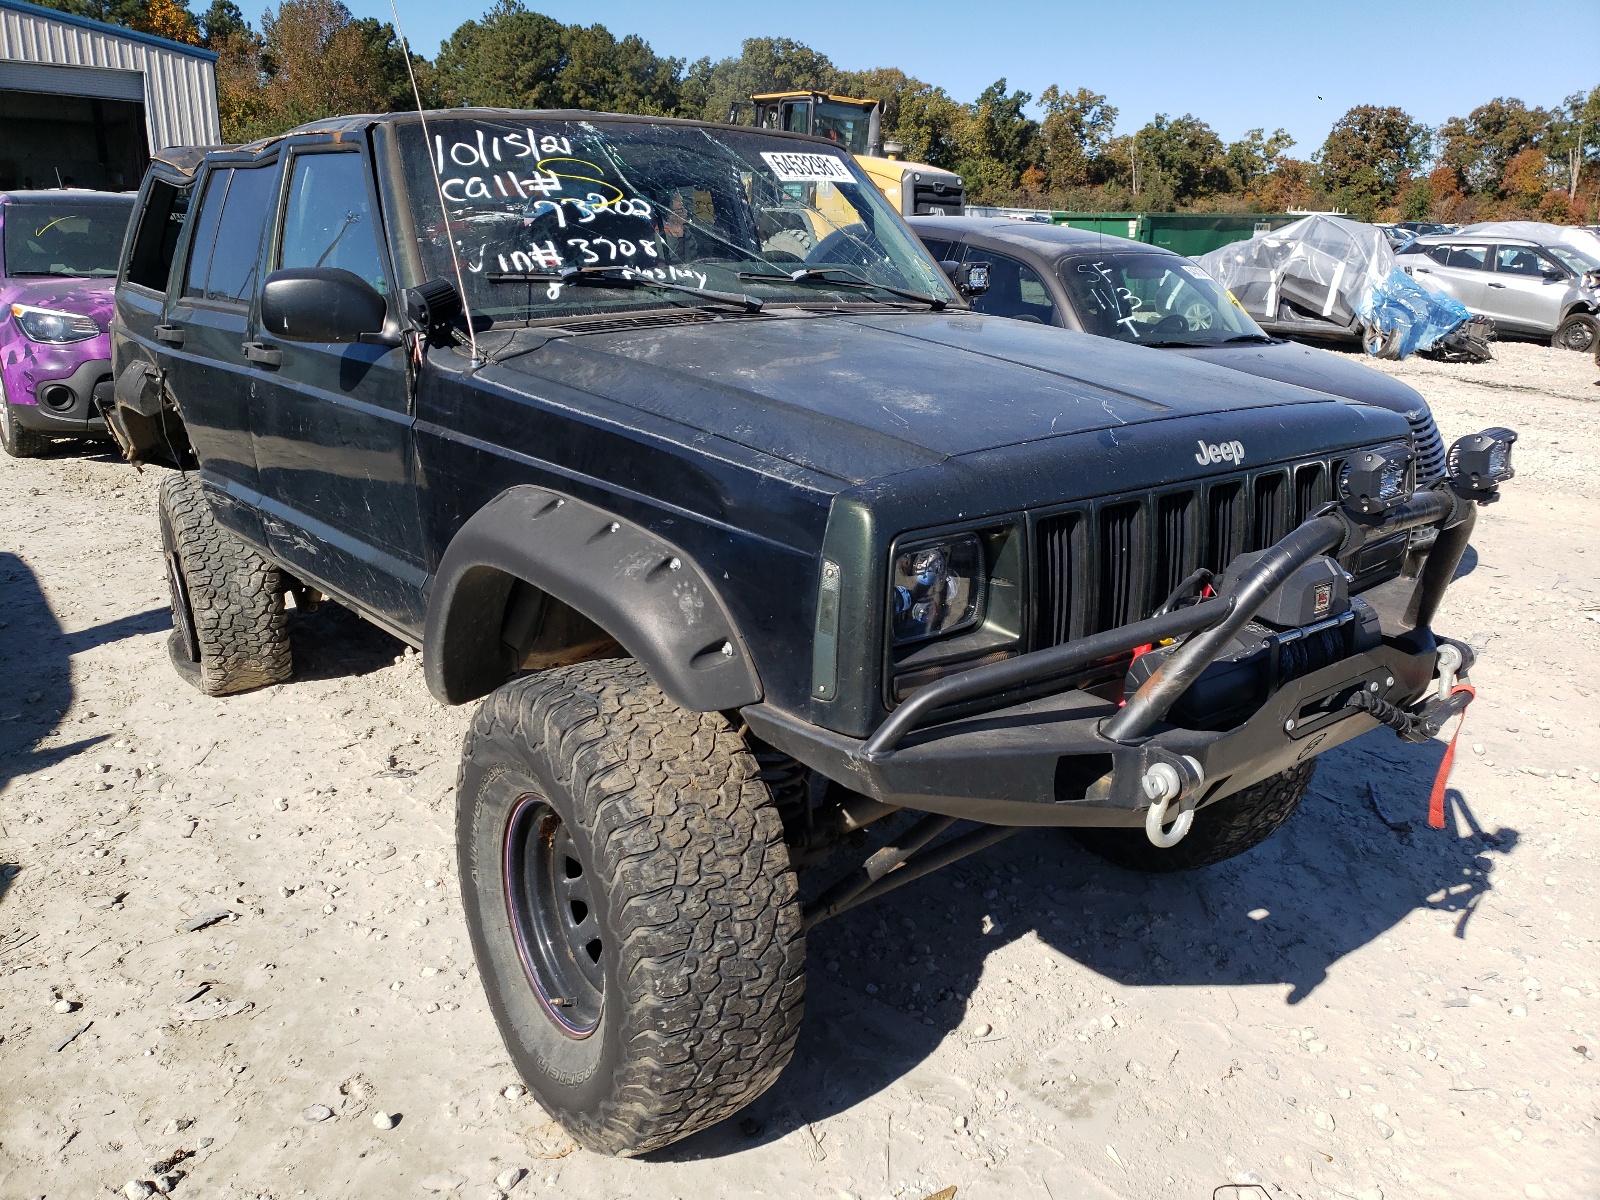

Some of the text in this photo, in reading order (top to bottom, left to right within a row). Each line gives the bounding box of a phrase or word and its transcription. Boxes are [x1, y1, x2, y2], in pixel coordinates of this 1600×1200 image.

[435, 128, 572, 174] 10/15/21
[771, 154, 842, 176] 64532981
[533, 192, 652, 228] 73202
[567, 238, 658, 263] 3708
[1195, 440, 1245, 466] Jeep
